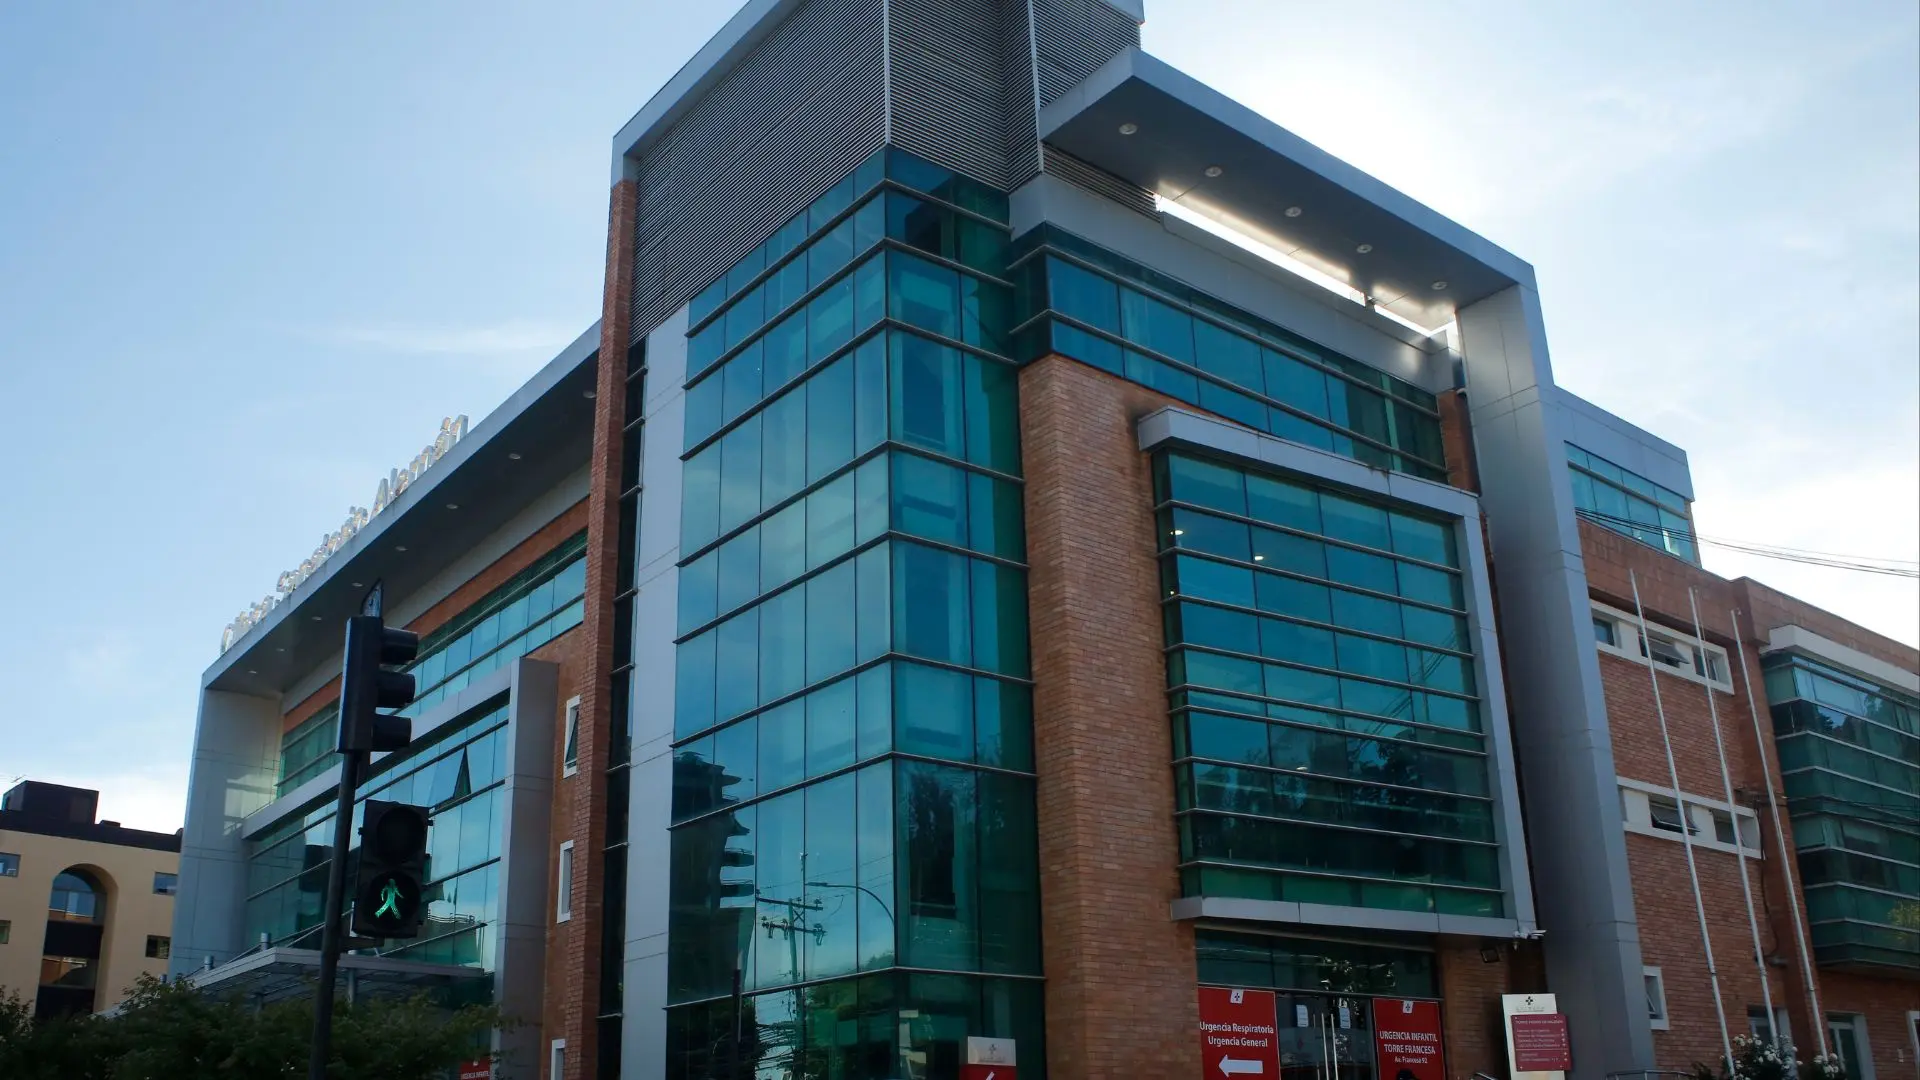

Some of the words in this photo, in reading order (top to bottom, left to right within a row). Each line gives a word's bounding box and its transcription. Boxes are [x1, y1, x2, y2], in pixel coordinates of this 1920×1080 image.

[1199, 1021, 1231, 1032] Urgencia
[1232, 1023, 1274, 1034] Respiratoria
[1208, 1036, 1240, 1047] Urgencia
[1241, 1037, 1268, 1047] General
[1379, 1030, 1410, 1040] URGENCIA
[1411, 1032, 1438, 1042] INFANTIL
[1384, 1044, 1404, 1053] TORRE
[1405, 1045, 1436, 1054] FRANCESA
